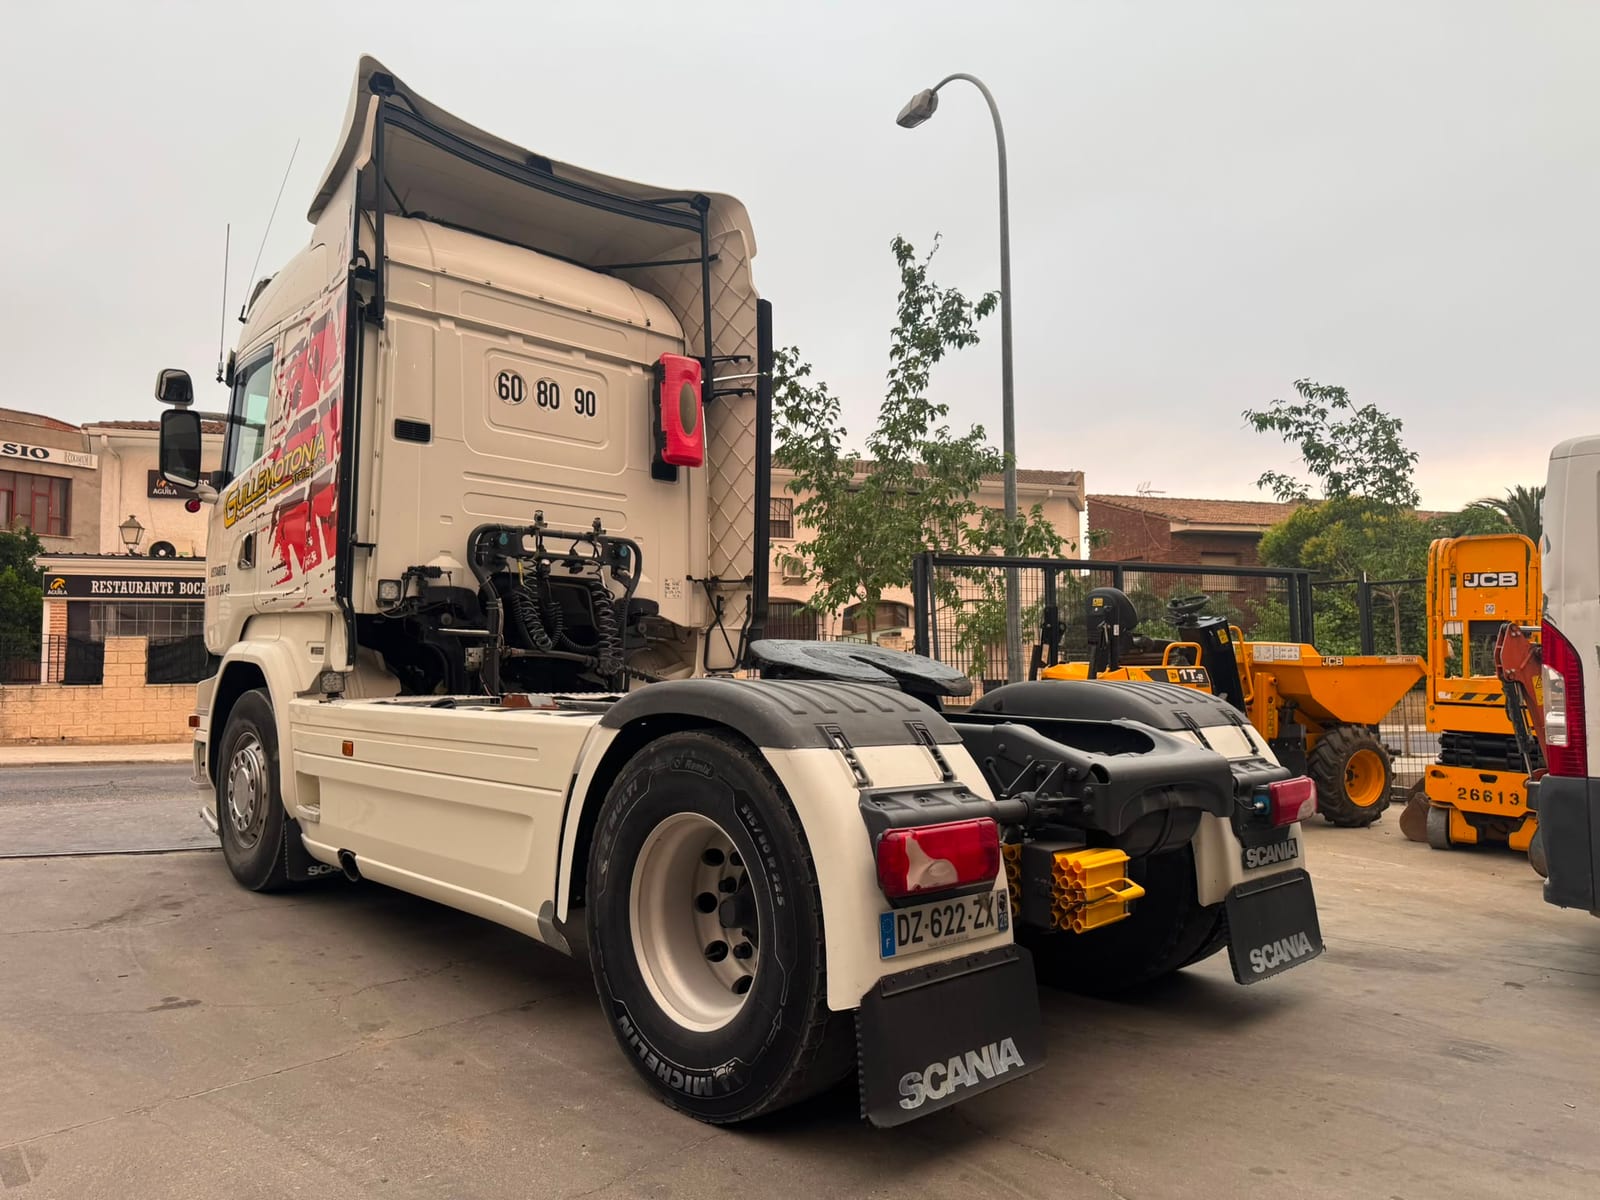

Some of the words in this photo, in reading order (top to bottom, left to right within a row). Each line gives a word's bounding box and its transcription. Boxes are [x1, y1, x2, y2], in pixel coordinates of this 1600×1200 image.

[498, 372, 522, 402] 60
[537, 380, 560, 410] 80
[574, 387, 596, 417] 90
[91, 580, 174, 595] RESTAURANTE
[1464, 572, 1517, 587] JCB
[1322, 656, 1344, 667] JCB
[1457, 787, 1520, 806] 26613
[1246, 839, 1298, 869] SCANIA
[1249, 931, 1314, 974] SCANIA
[618, 1014, 714, 1097] MICHELIN
[898, 1036, 1025, 1110] SCANIA
